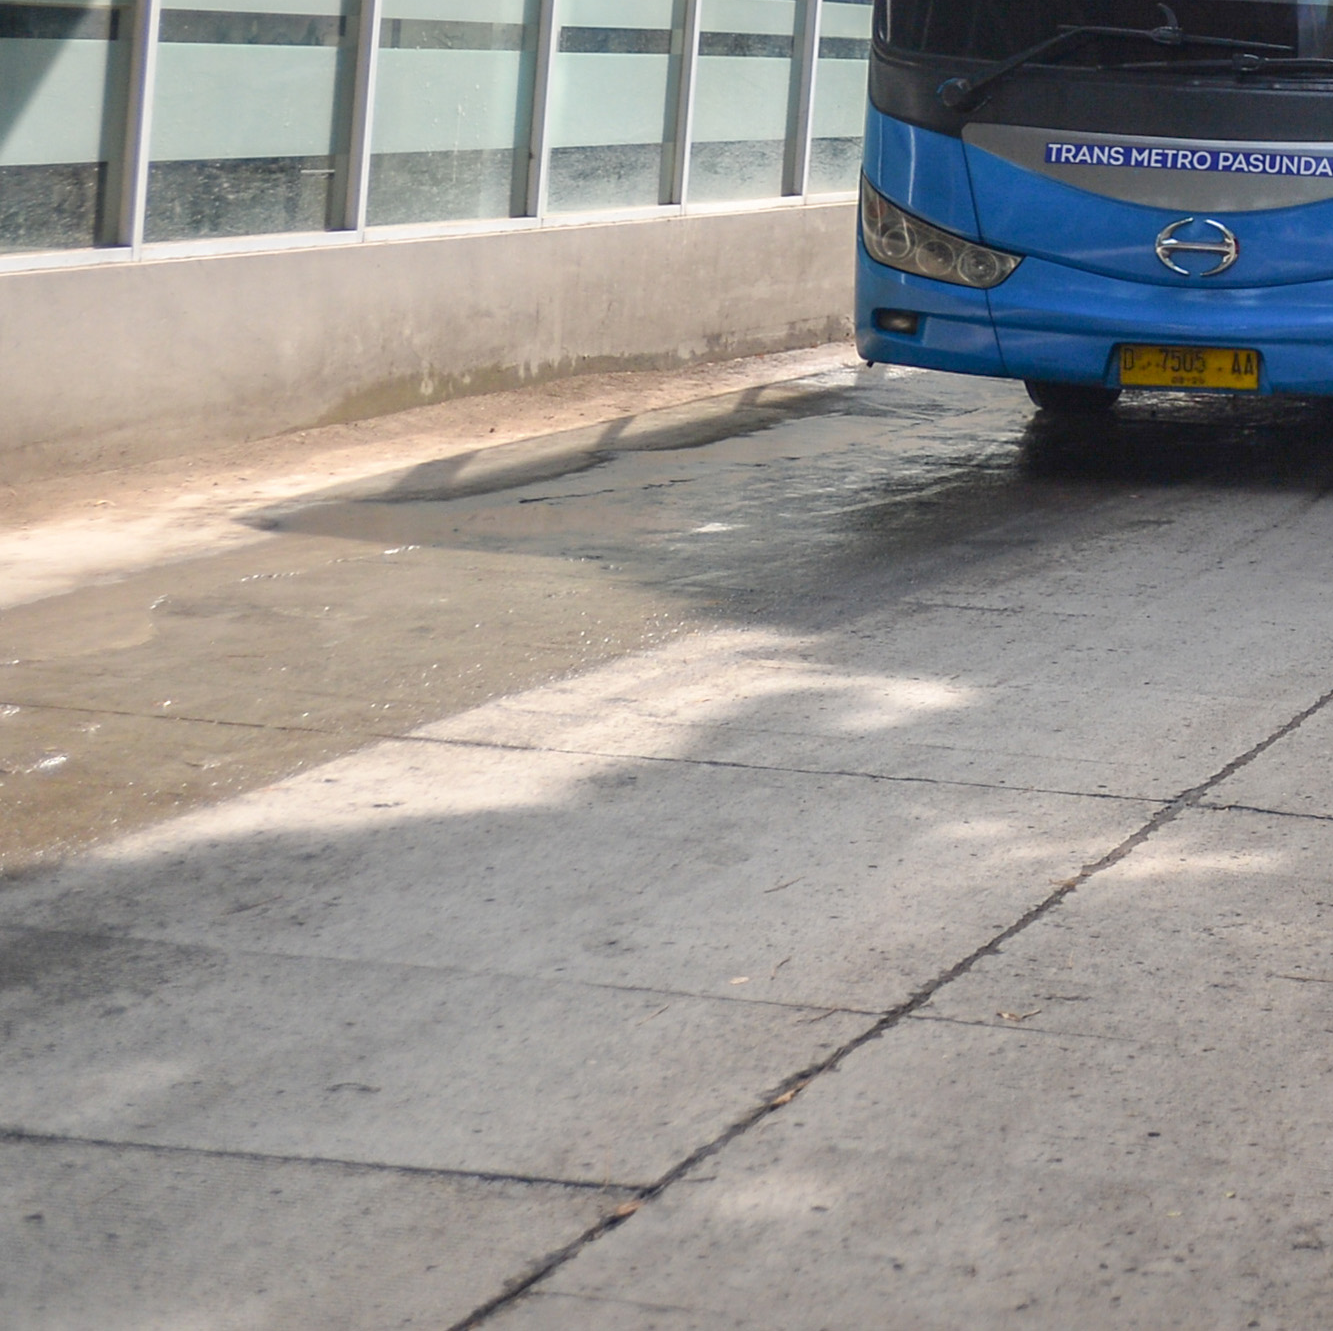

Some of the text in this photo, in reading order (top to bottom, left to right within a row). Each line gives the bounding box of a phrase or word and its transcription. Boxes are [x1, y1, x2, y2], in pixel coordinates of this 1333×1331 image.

[1048, 144, 1124, 166] TRANS
[1131, 148, 1212, 170] METRO
[1124, 348, 1134, 370] D
[1231, 351, 1254, 376] AA
